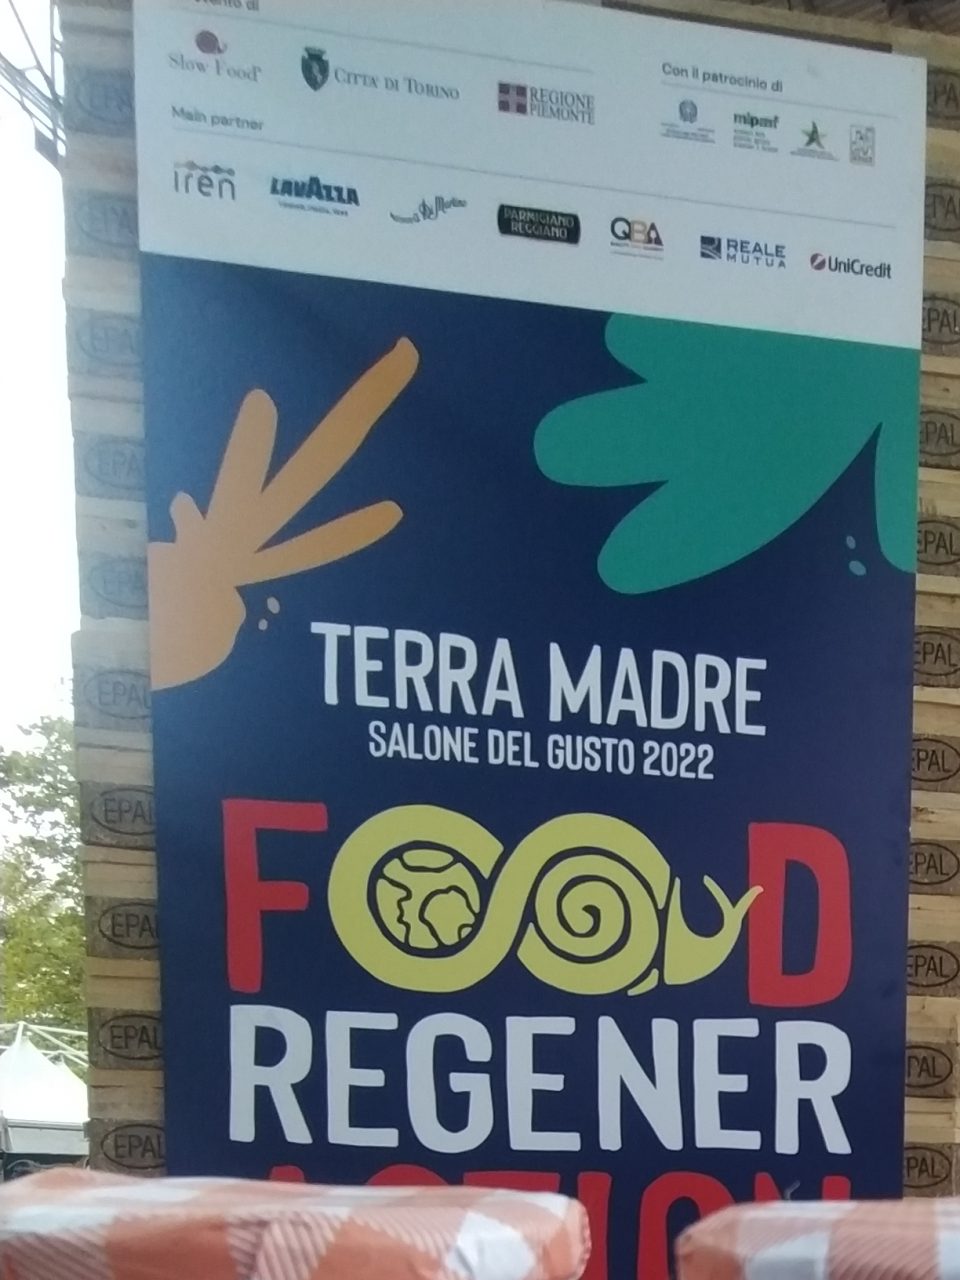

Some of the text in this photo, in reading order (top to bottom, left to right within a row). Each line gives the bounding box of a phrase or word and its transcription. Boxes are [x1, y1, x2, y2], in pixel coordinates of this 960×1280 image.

[662, 62, 783, 92] Con il patrocinio di
[529, 86, 595, 109] REGIONE
[171, 105, 264, 131] Main partner
[529, 102, 595, 125] PIEMONTE
[270, 176, 360, 206] LAVAZZA
[504, 207, 575, 229] PARMIGIANO
[511, 222, 568, 240] REGGIANO
[610, 217, 664, 246] QBA
[726, 238, 786, 258] REALE
[726, 253, 786, 269] MUTUA
[828, 256, 892, 279] UniCredit
[311, 622, 767, 736] TERRA MADRE
[368, 720, 714, 780] SALONE DEL GUSTO 2022
[907, 1055, 943, 1079] PAL
[229, 1004, 852, 1155] REGENER
[907, 1155, 942, 1179] PAL
